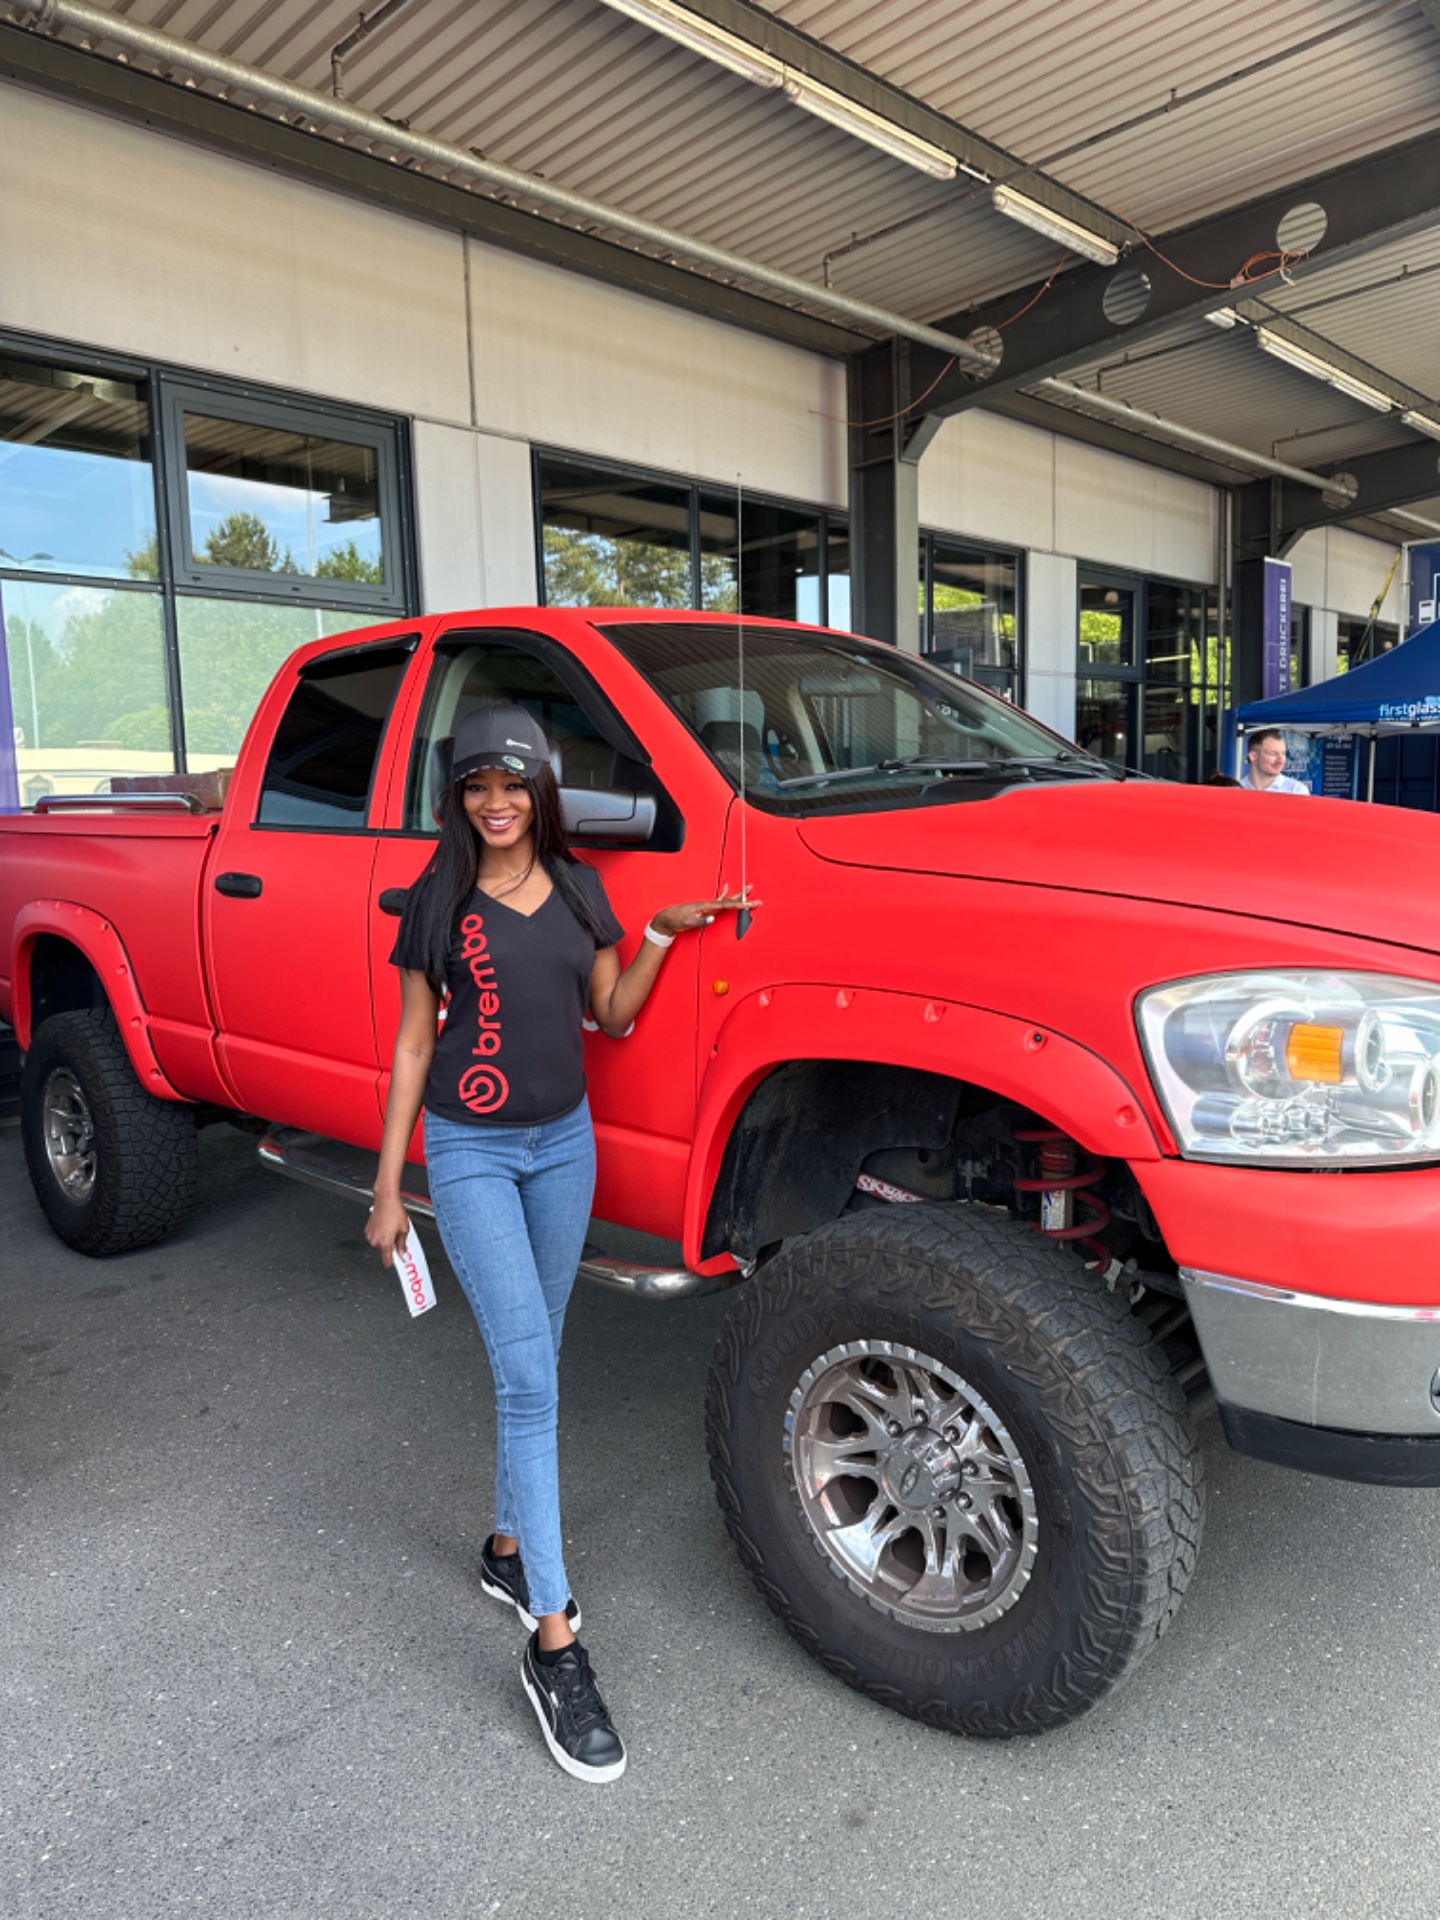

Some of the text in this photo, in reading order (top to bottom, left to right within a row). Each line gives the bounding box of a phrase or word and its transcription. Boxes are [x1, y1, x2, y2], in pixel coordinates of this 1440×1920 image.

[1279, 578, 1287, 669] DRUCKEREI
[460, 913, 502, 1056] brembo
[405, 1246, 426, 1306] mbo
[846, 1609, 1055, 1689] WRANGLER
